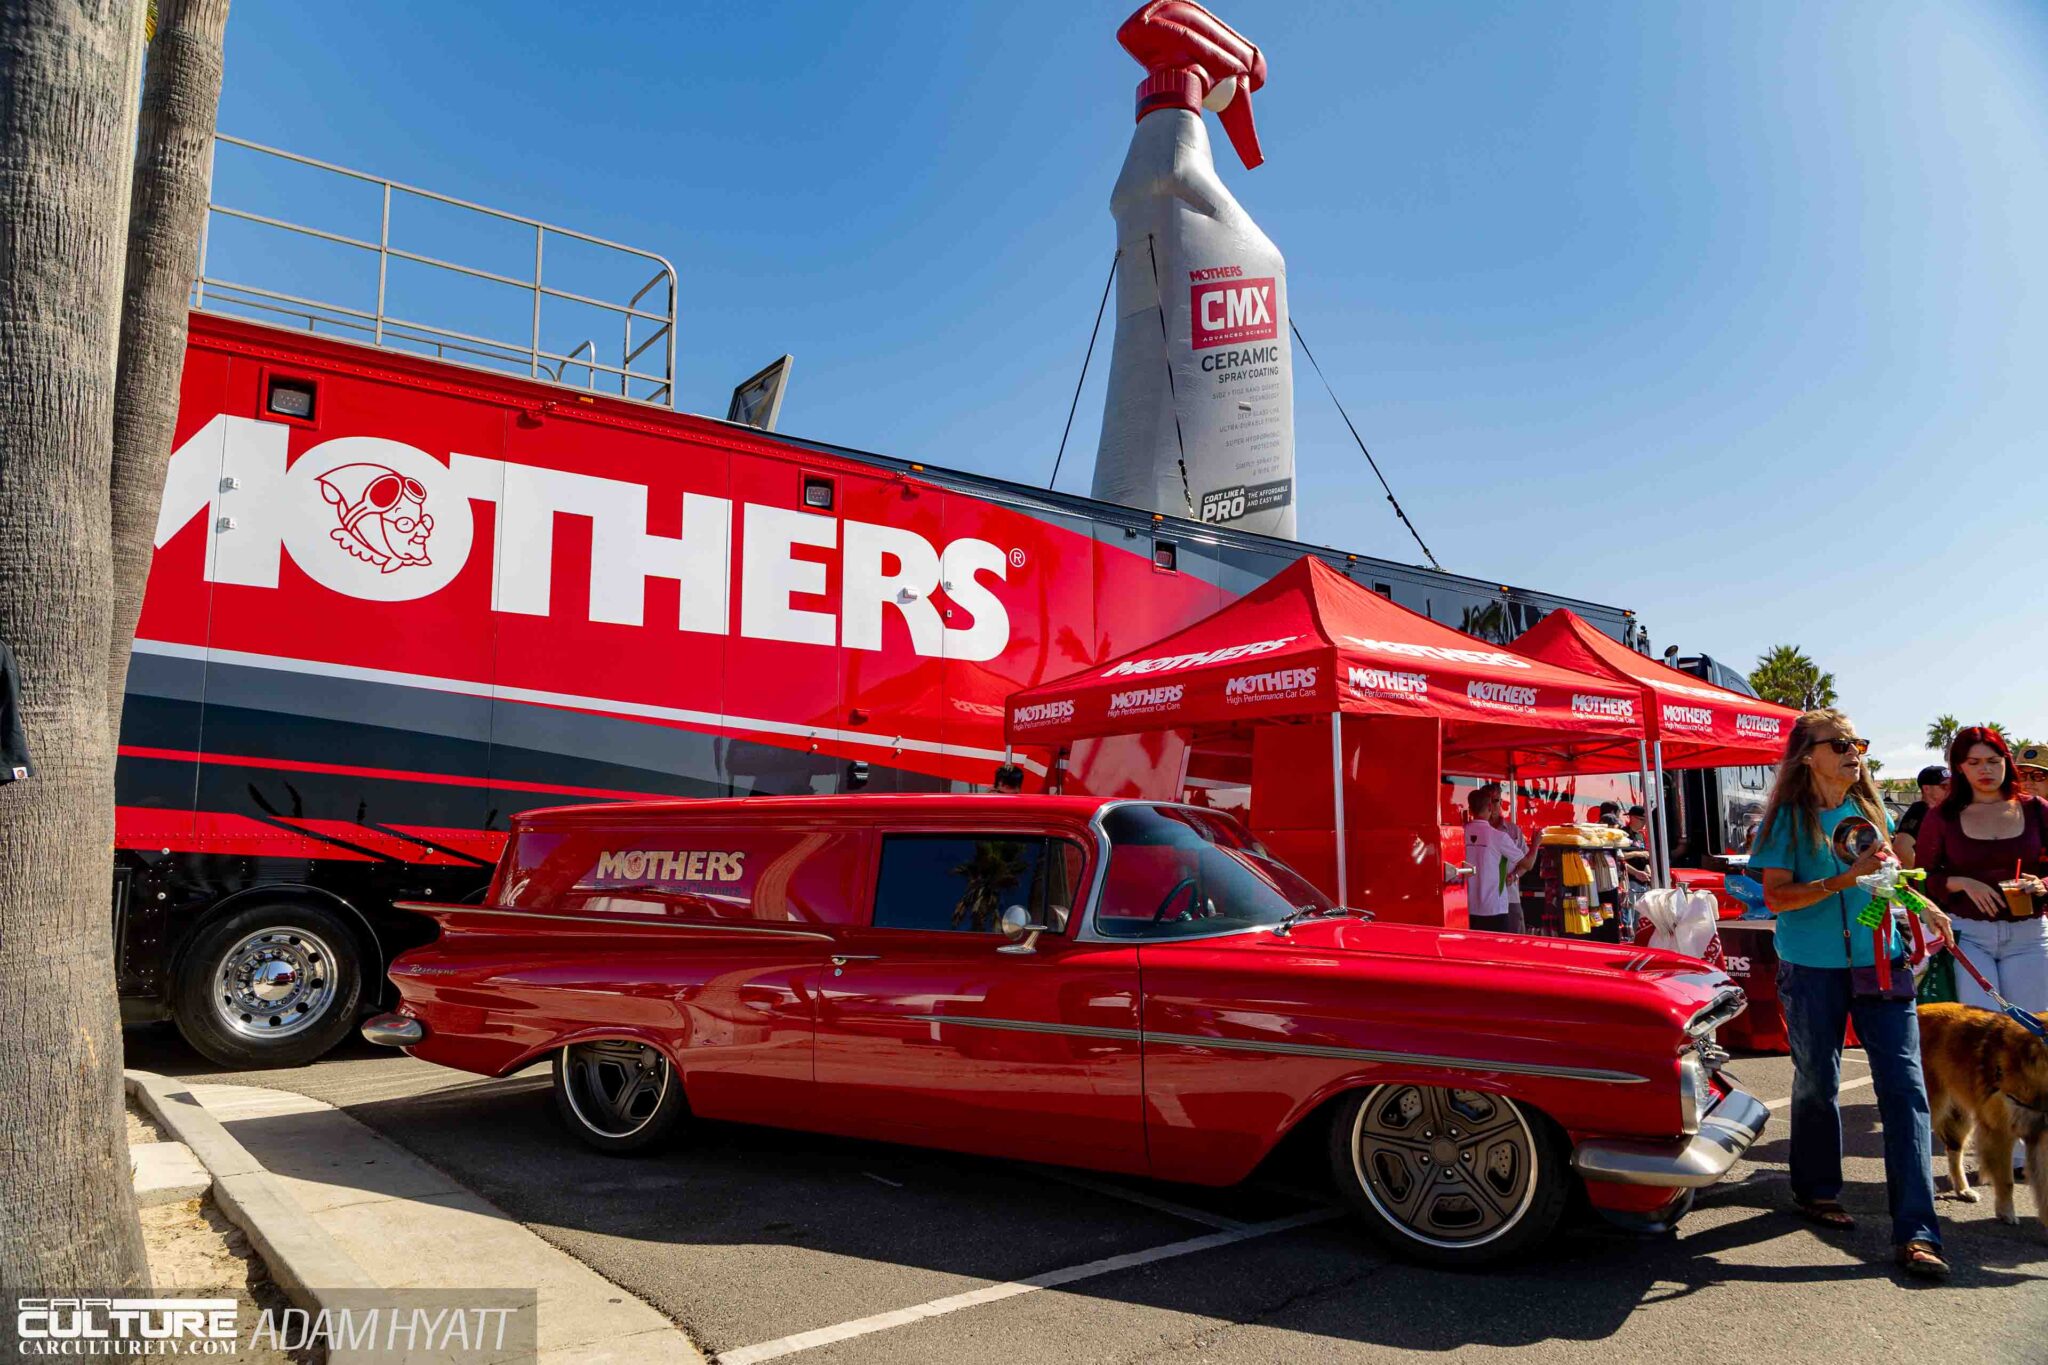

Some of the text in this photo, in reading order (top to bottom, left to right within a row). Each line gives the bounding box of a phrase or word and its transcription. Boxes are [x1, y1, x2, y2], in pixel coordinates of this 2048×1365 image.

[1189, 266, 1243, 282] MOTHERS
[1201, 286, 1271, 331] CMX
[1203, 328, 1272, 342] ADVANCED SCIENCE
[1201, 346, 1278, 372] CERAMIC
[1219, 366, 1279, 384] SPRAY COATING
[1204, 487, 1245, 504] COAT LIKE A
[1247, 485, 1288, 499] THE AFFORDABLE
[1259, 497, 1272, 505] EASY
[1273, 494, 1283, 502] WAY
[1202, 496, 1246, 522] PRO
[1101, 636, 1298, 678] MOTHERS
[1225, 667, 1317, 696] MOTHERS
[1348, 667, 1428, 693] MOTHERS
[1110, 684, 1184, 710] MOTHERS
[1226, 688, 1316, 705] High Performance Car Care
[1467, 680, 1538, 706] MOTHERS
[1013, 699, 1075, 724] MOTHERS
[1107, 702, 1180, 718] High Performance Car Care
[1572, 694, 1633, 717] MOTHERS
[1663, 704, 1712, 725] MOTHERS
[1736, 713, 1780, 734] MOTHERS
[596, 850, 745, 881] MOTHERS
